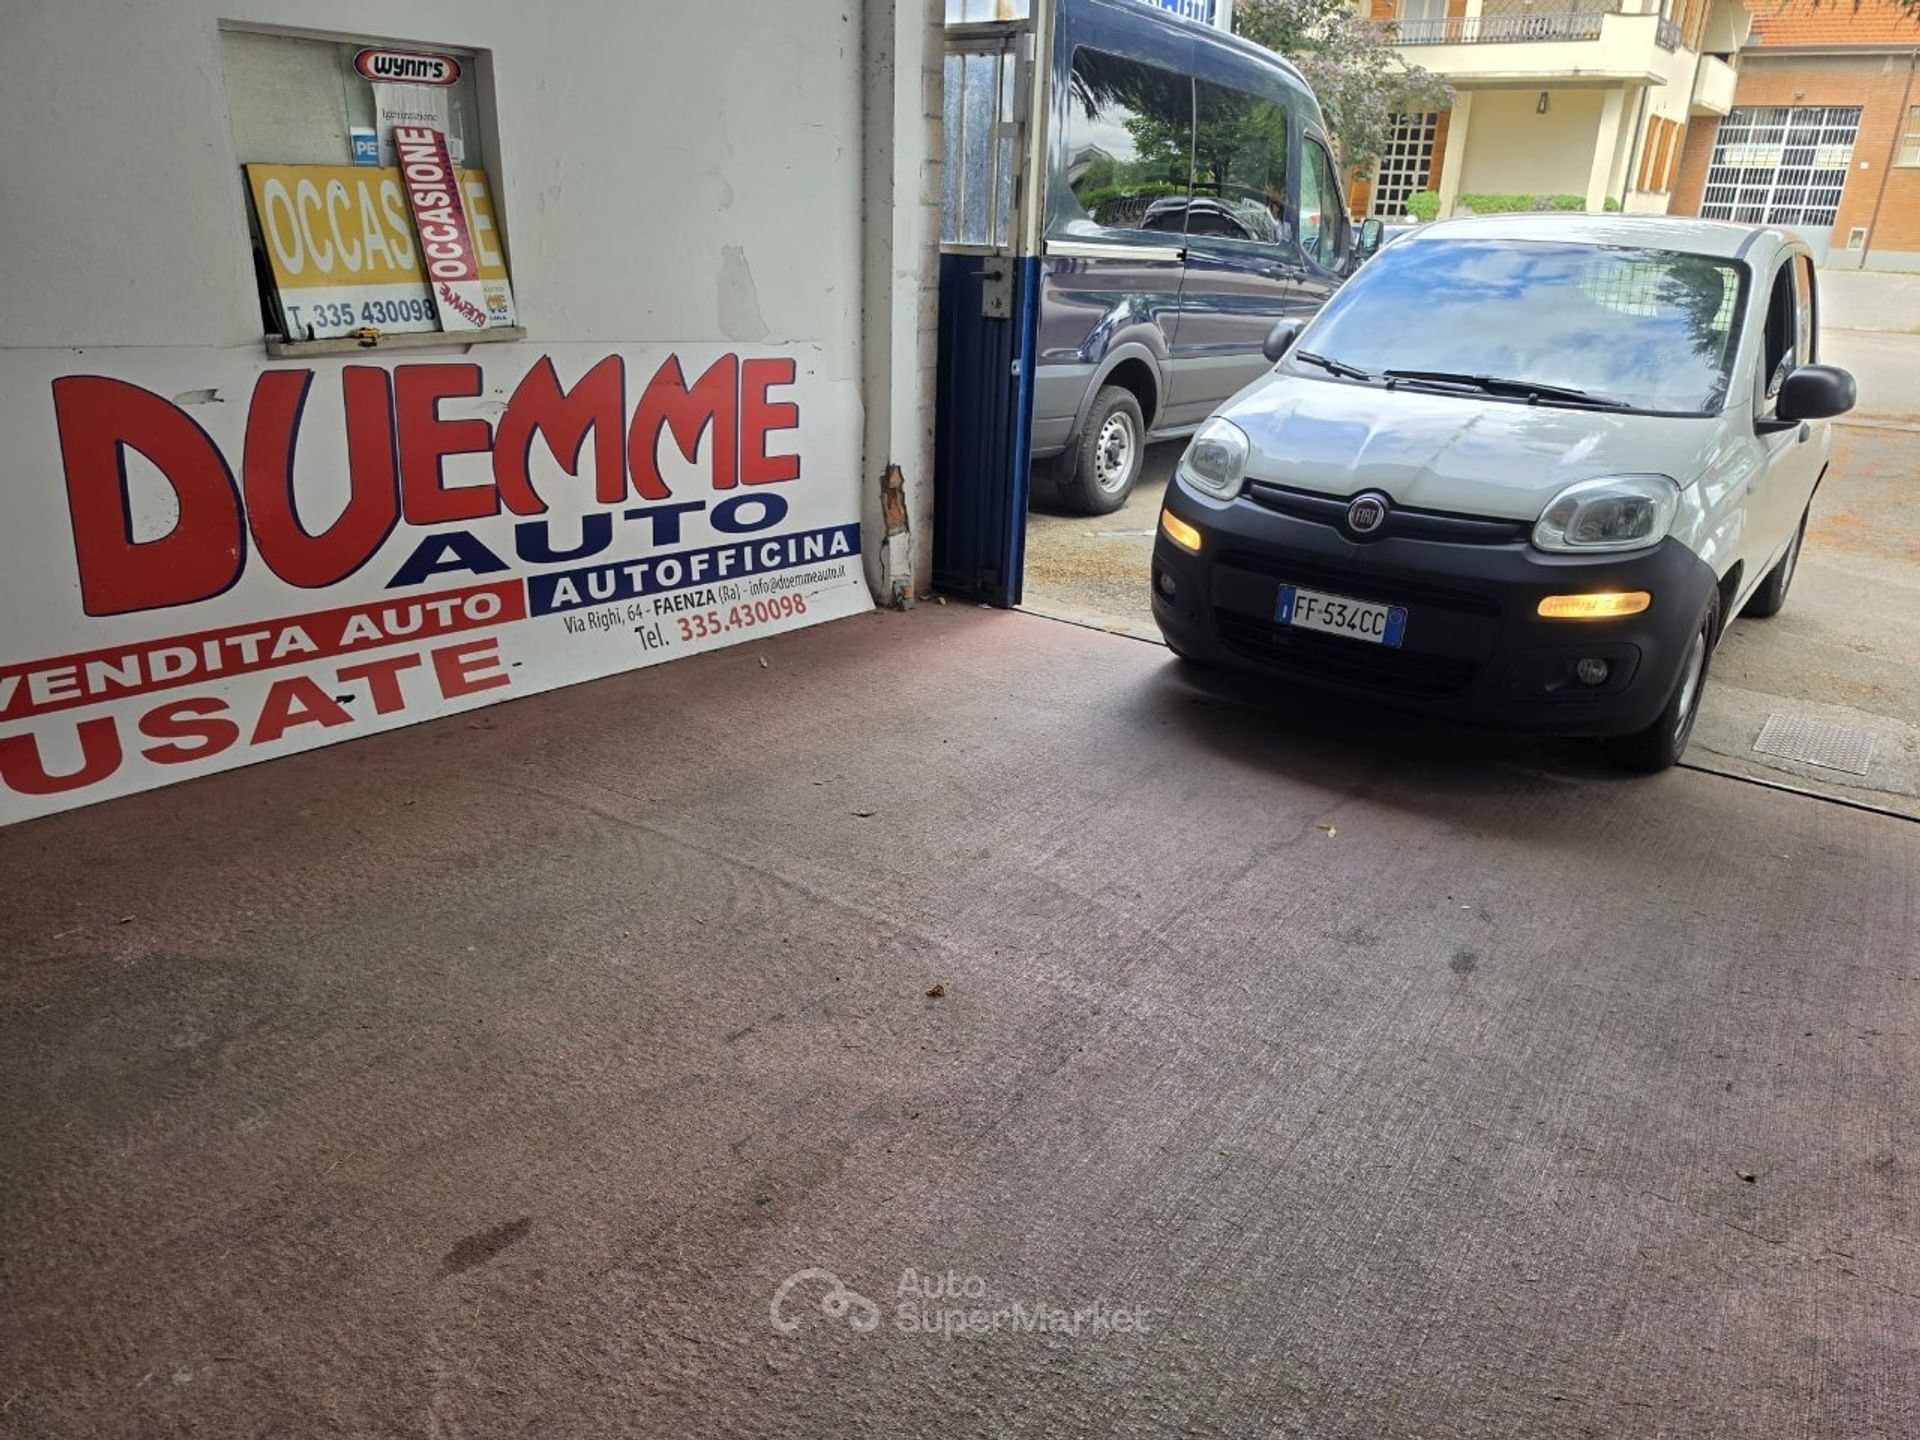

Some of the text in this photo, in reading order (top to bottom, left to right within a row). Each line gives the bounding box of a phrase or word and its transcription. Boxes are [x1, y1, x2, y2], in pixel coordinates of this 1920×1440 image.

[263, 178, 501, 275] OCCASE
[396, 128, 468, 279] OCCASIONE
[313, 303, 355, 328] 335
[361, 298, 436, 325] 430098
[52, 352, 800, 617] DUEMME
[1355, 508, 1377, 525] FIAT
[384, 492, 788, 589] AUTO
[551, 530, 850, 607] AUTOFFICINA
[340, 592, 501, 646] AUTO
[564, 614, 586, 634] Via
[587, 608, 626, 632] Righi,
[627, 603, 643, 621] 64
[653, 589, 717, 616] FAENZA
[718, 583, 741, 604] (Ra)
[750, 565, 846, 596] info@duemmeauto.it
[634, 593, 806, 650] Tel. 335.430098
[0, 637, 511, 796] USATE
